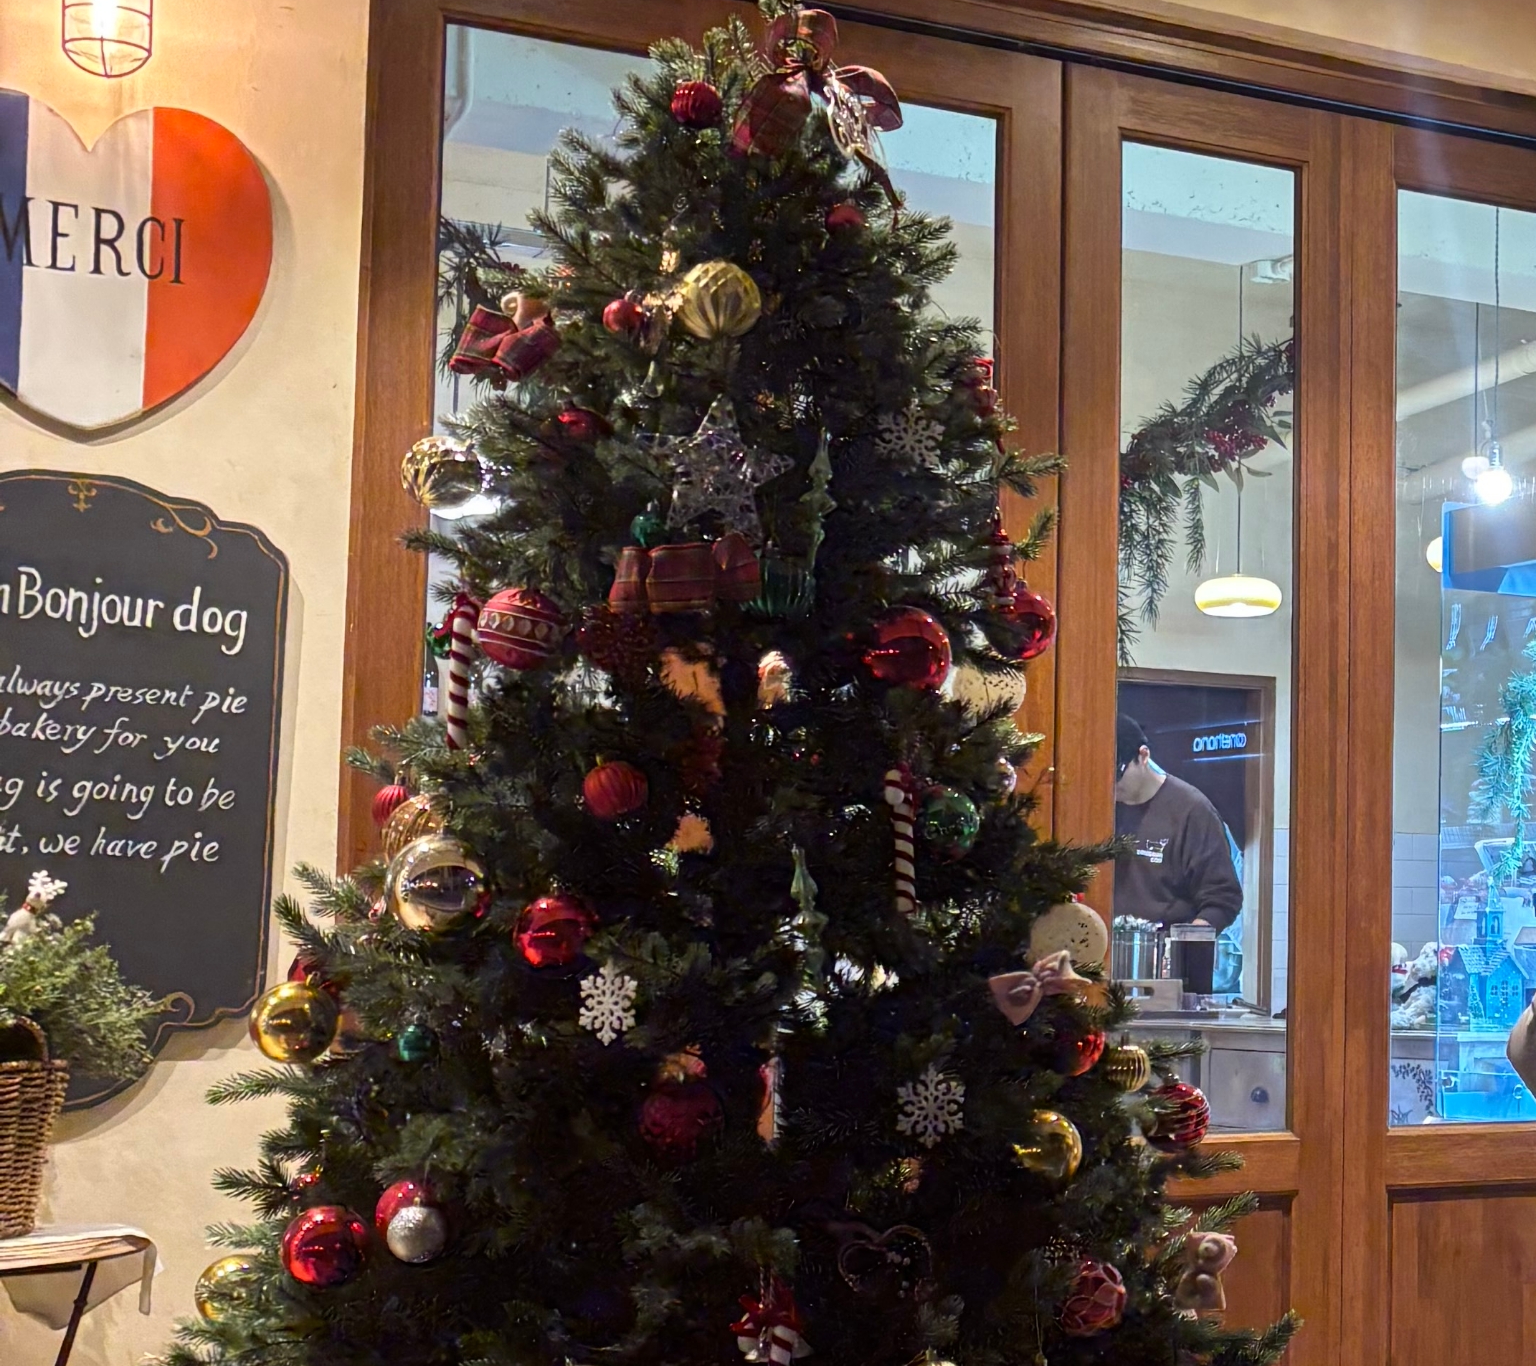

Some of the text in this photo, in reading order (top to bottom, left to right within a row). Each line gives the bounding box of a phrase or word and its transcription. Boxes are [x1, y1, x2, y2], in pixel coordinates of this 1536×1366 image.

[0, 195, 185, 285] MERCI
[18, 566, 164, 638] Bonjour
[173, 586, 248, 655] dog
[82, 682, 193, 711] present
[191, 687, 248, 724] pie
[93, 717, 147, 754] for
[153, 736, 220, 760] you
[37, 771, 62, 802] is
[64, 774, 155, 820] going
[165, 778, 193, 806] to
[197, 777, 235, 811] be
[39, 834, 81, 855] we
[90, 827, 157, 859] have
[160, 832, 219, 873] pie
